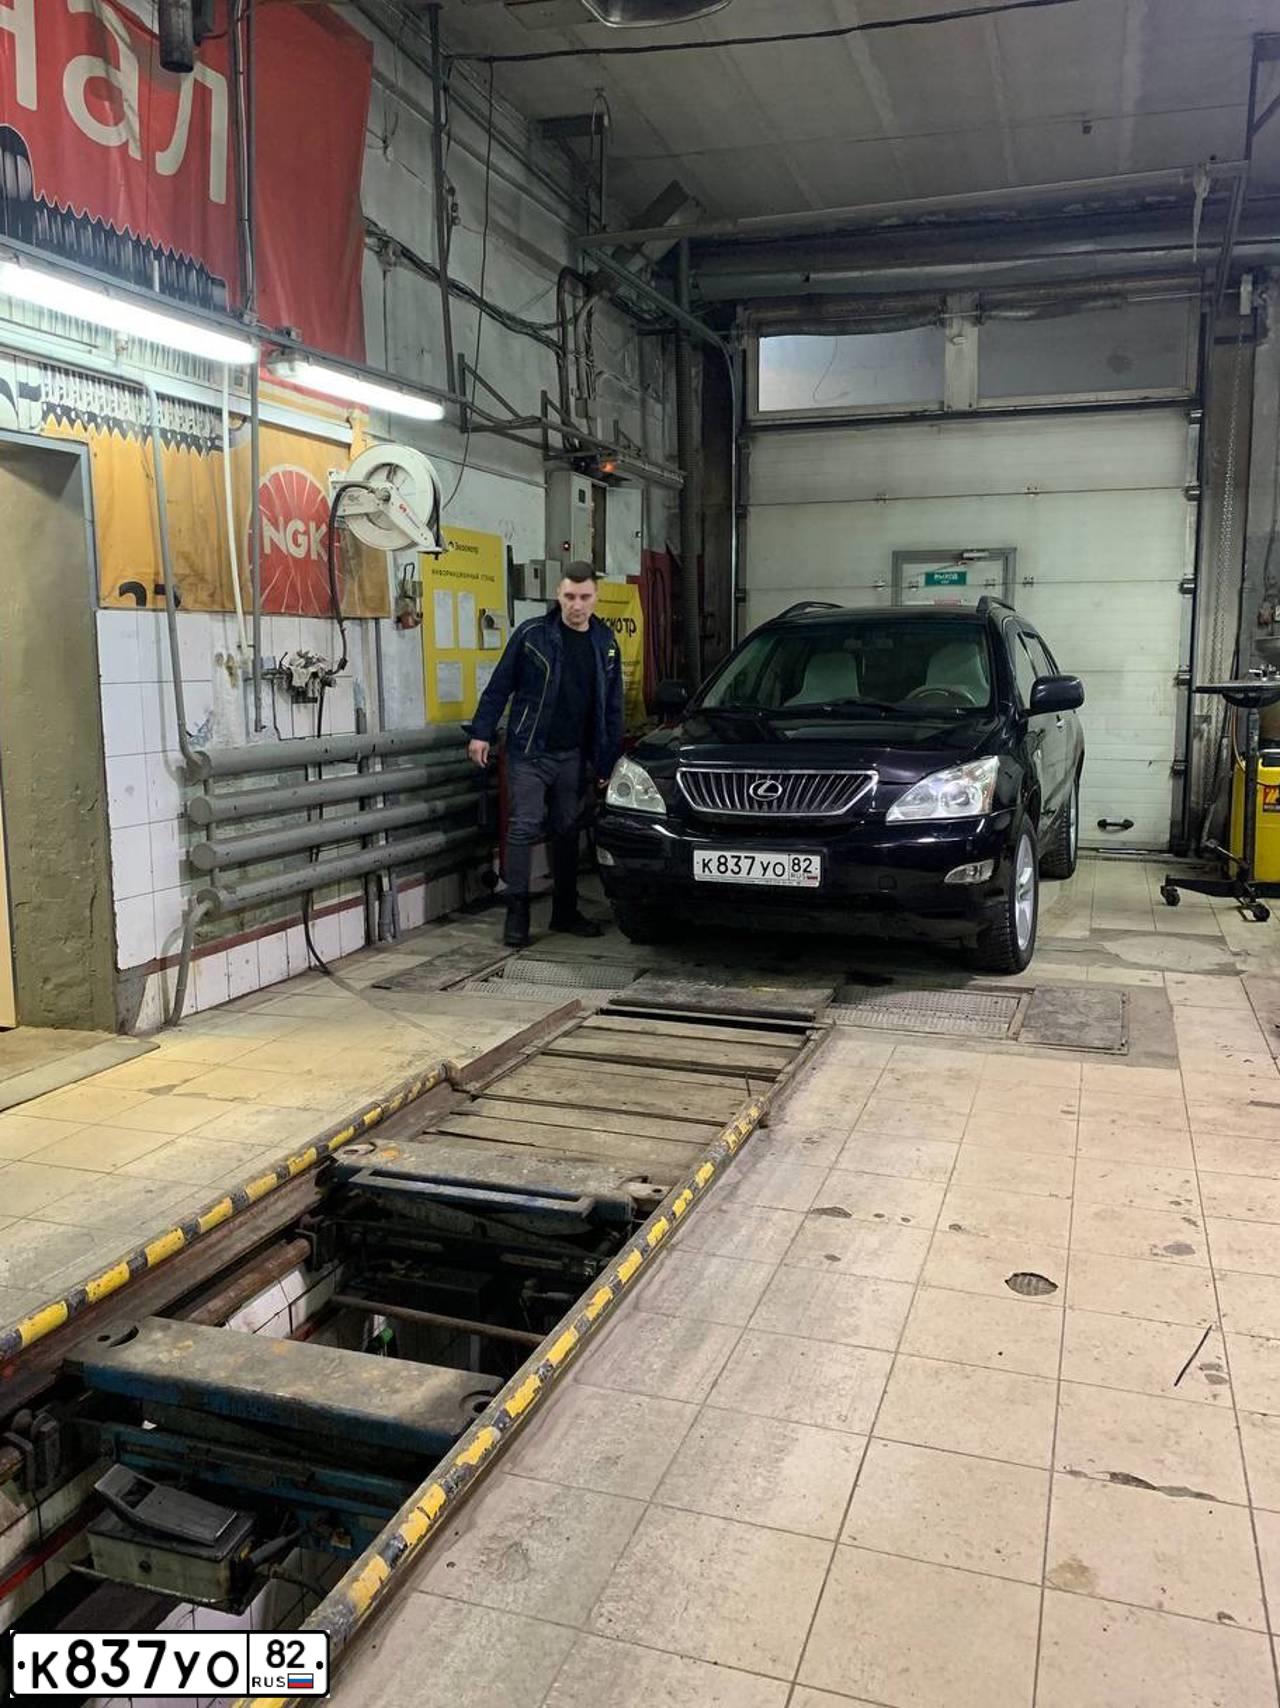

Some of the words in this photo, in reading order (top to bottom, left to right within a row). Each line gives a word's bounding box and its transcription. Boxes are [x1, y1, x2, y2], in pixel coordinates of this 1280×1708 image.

[262, 514, 329, 560] NGK
[702, 855, 785, 877] К837УО
[792, 857, 812, 873] 82
